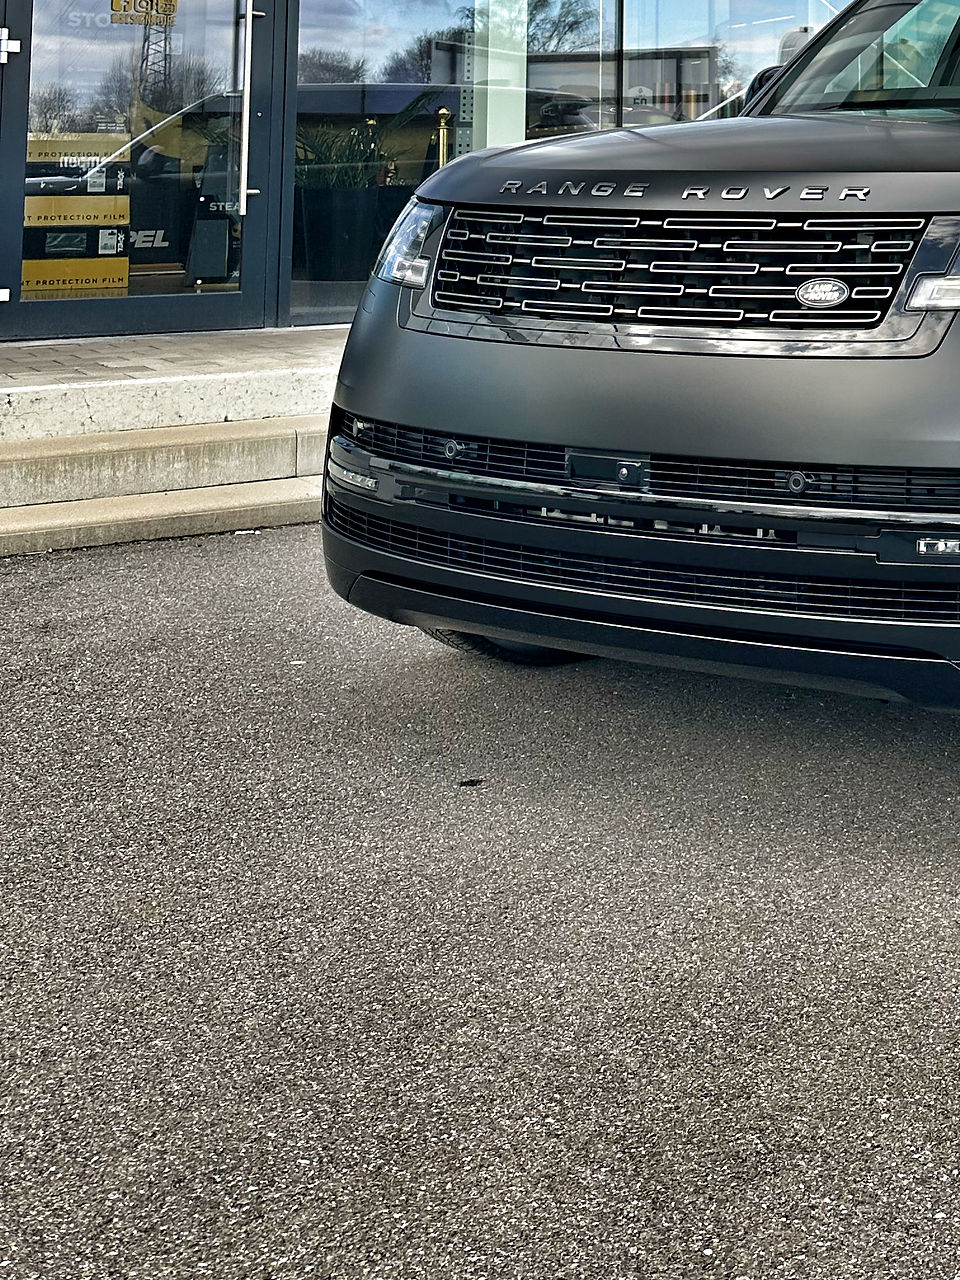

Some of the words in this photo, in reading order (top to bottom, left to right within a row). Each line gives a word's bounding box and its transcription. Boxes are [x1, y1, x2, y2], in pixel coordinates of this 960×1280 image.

[499, 180, 650, 197] RANGE
[681, 184, 872, 202] ROVER
[36, 278, 98, 286] PROTECTION
